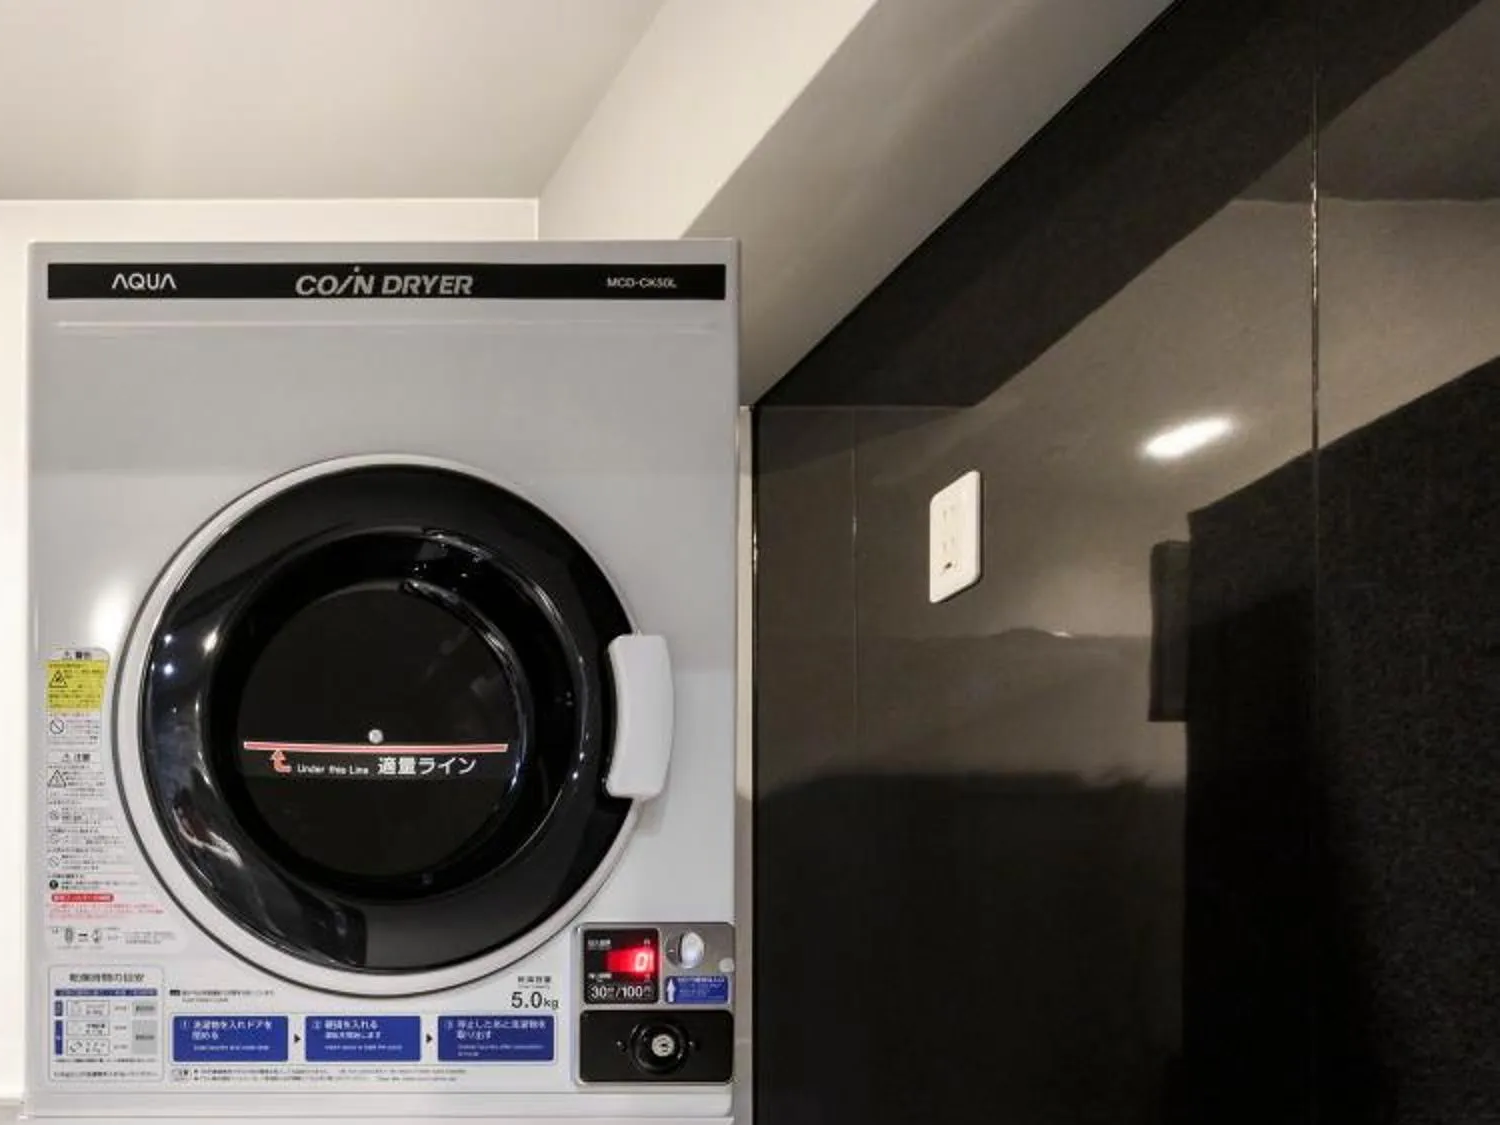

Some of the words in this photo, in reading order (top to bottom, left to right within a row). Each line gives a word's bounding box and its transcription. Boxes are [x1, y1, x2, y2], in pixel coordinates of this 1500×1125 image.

[111, 272, 178, 291] AQUA
[381, 275, 474, 296] DRYER
[296, 763, 326, 775] Under
[377, 756, 477, 775] 適量ライン
[511, 990, 560, 1010] 5.0kg
